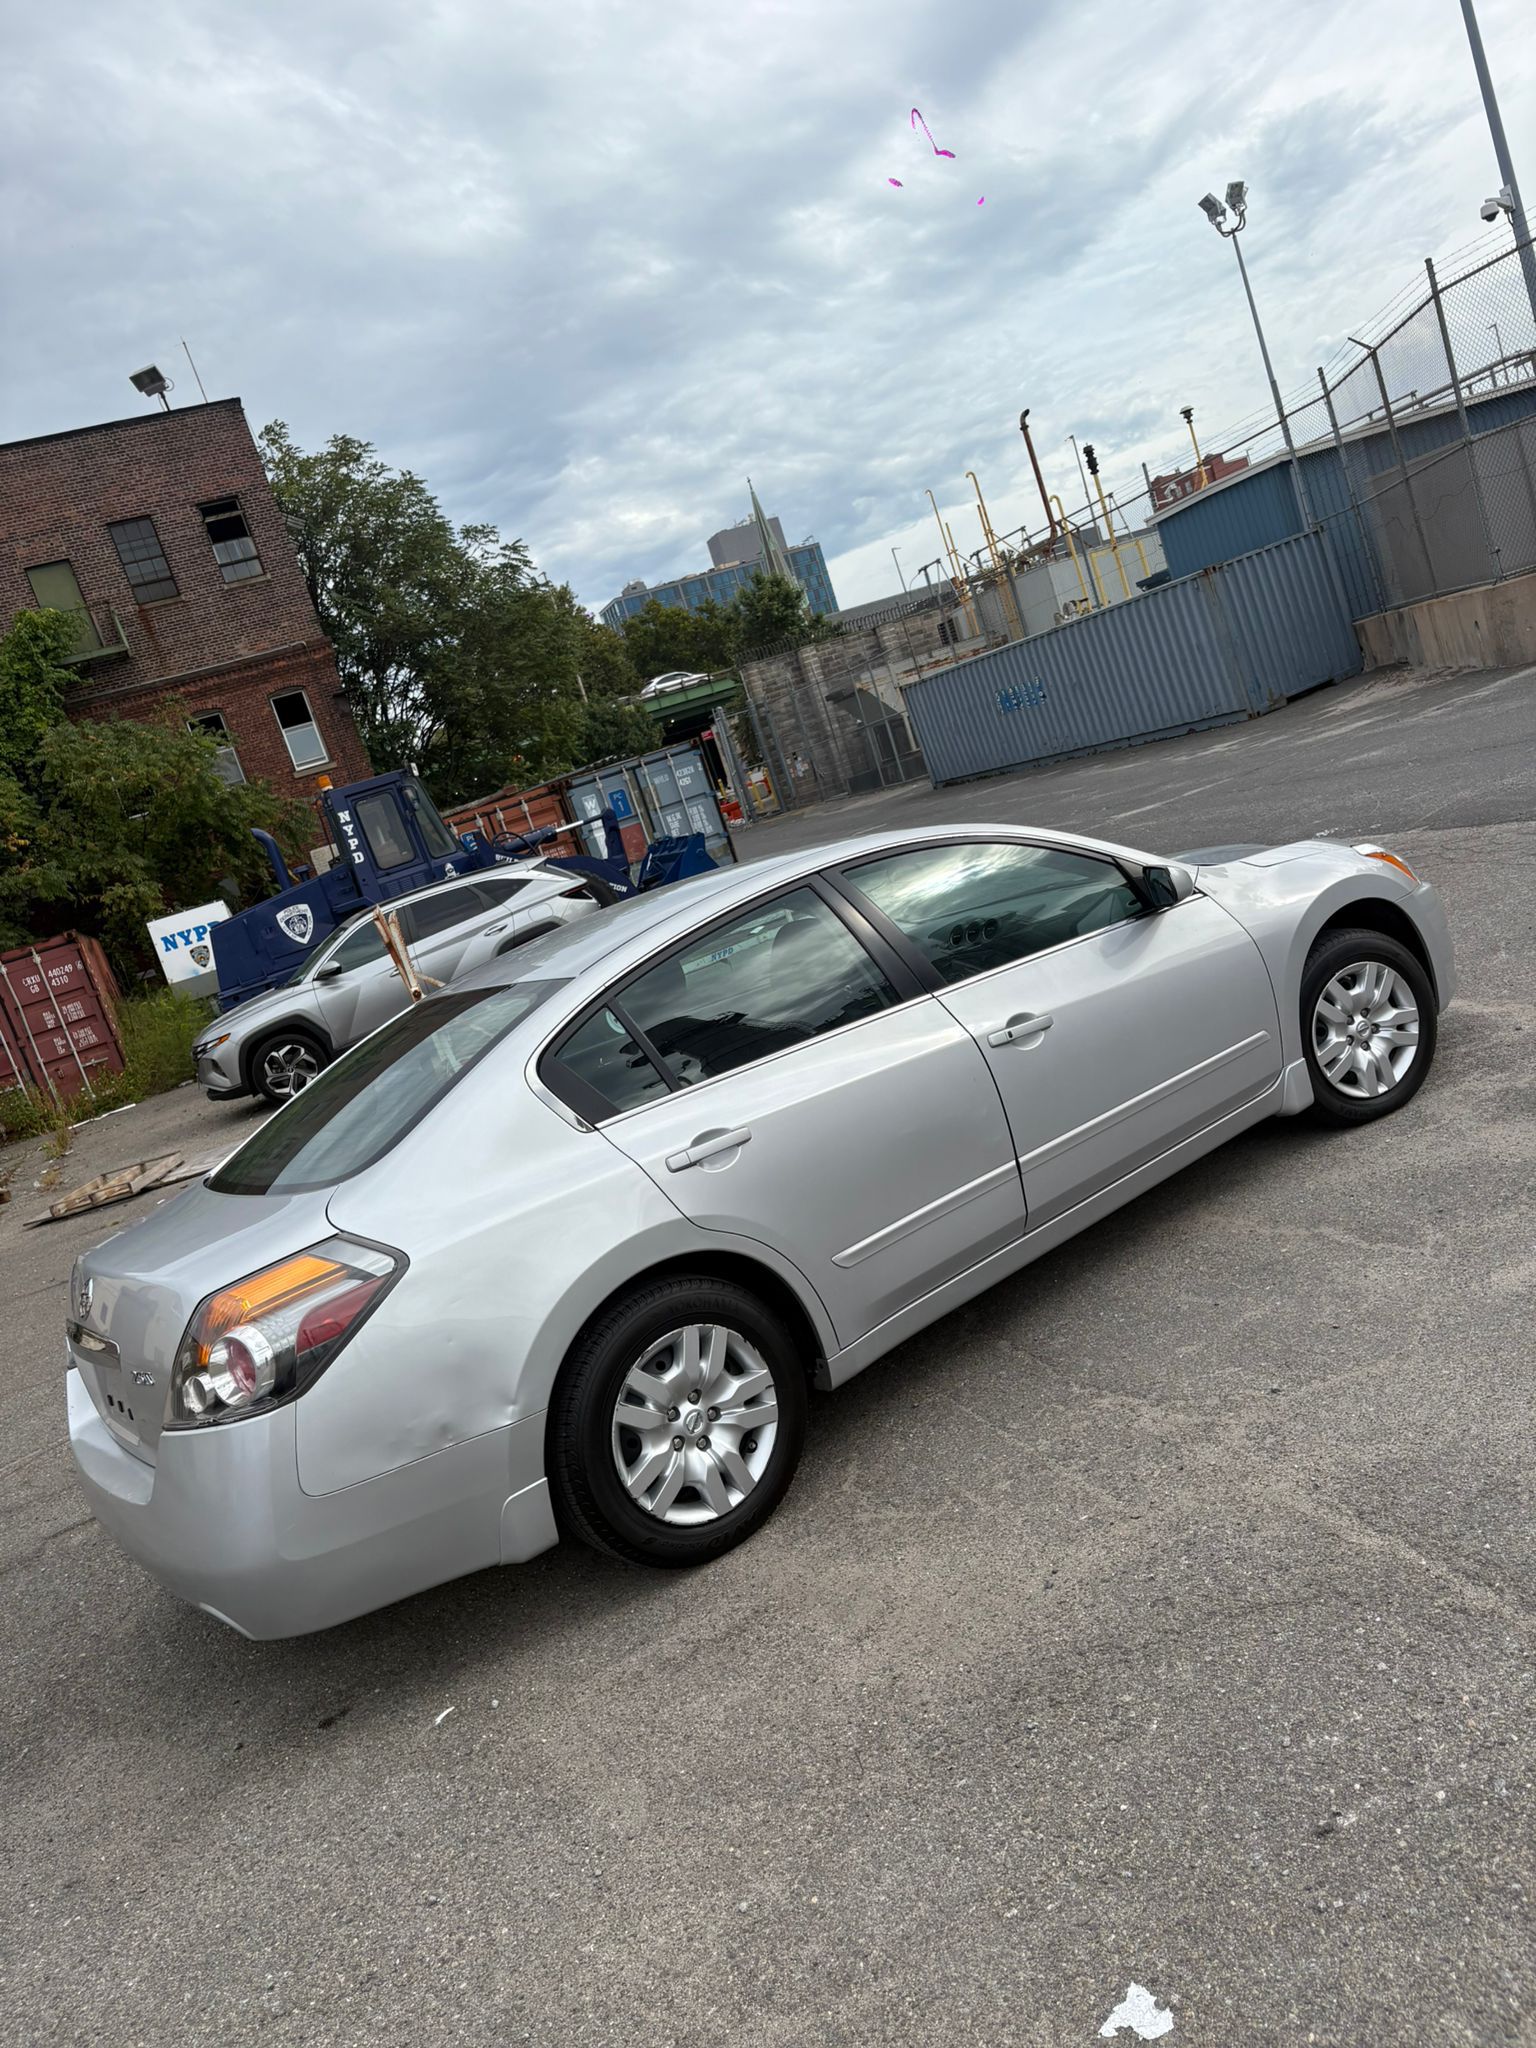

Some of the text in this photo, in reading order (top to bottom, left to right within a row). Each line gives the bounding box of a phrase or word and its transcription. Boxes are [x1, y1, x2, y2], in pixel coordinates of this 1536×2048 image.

[337, 810, 365, 864] NYPD
[711, 946, 735, 962] NYPD
[48, 963, 73, 978] 440249
[51, 975, 69, 987] 4310
